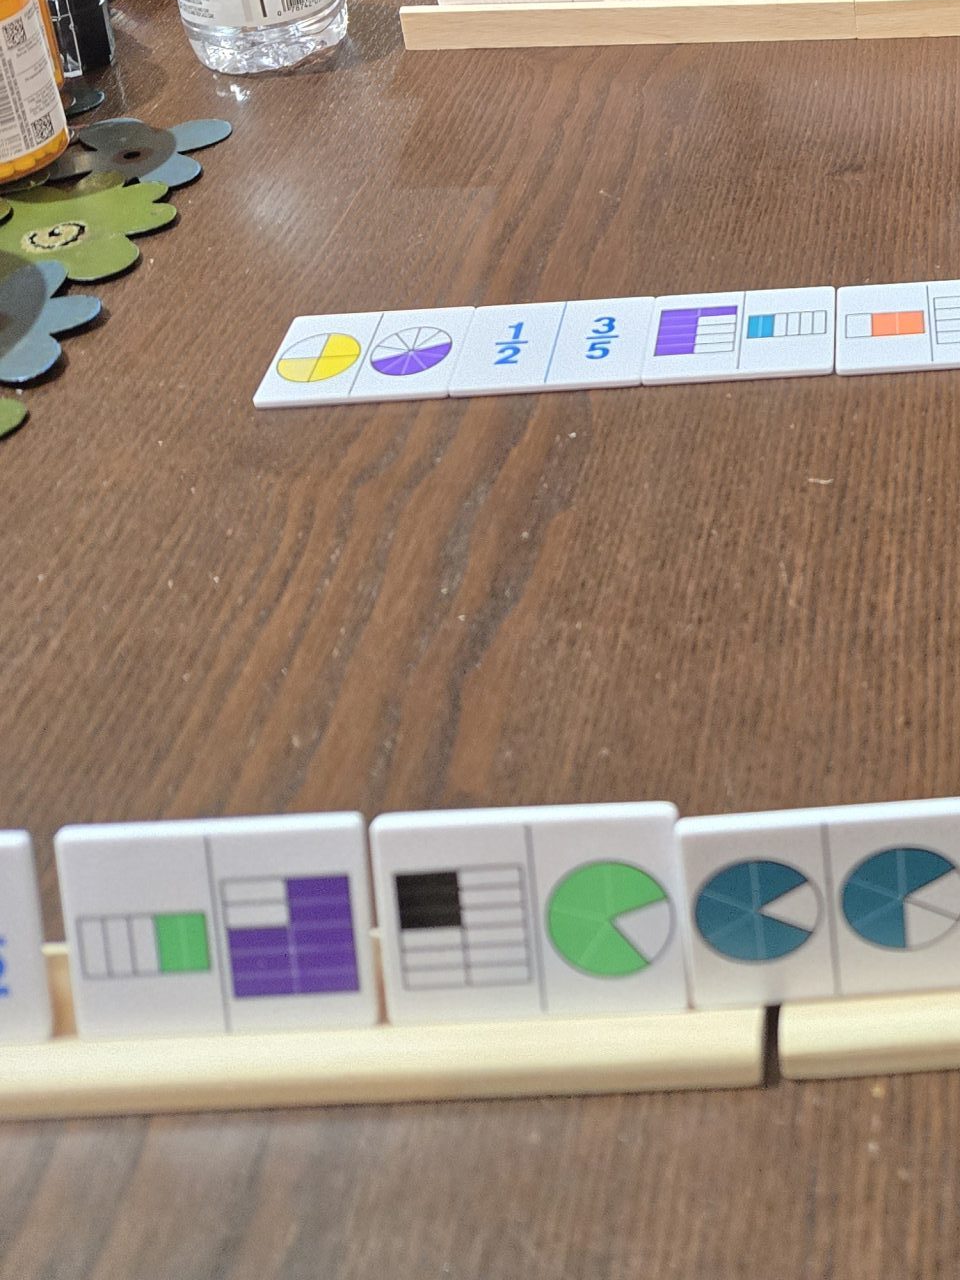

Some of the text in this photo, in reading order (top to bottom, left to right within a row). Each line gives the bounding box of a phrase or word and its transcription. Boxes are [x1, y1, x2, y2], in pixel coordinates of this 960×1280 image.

[508, 321, 524, 340] 1
[591, 316, 616, 334] 3
[494, 345, 521, 365] 2
[585, 340, 611, 360] 5
